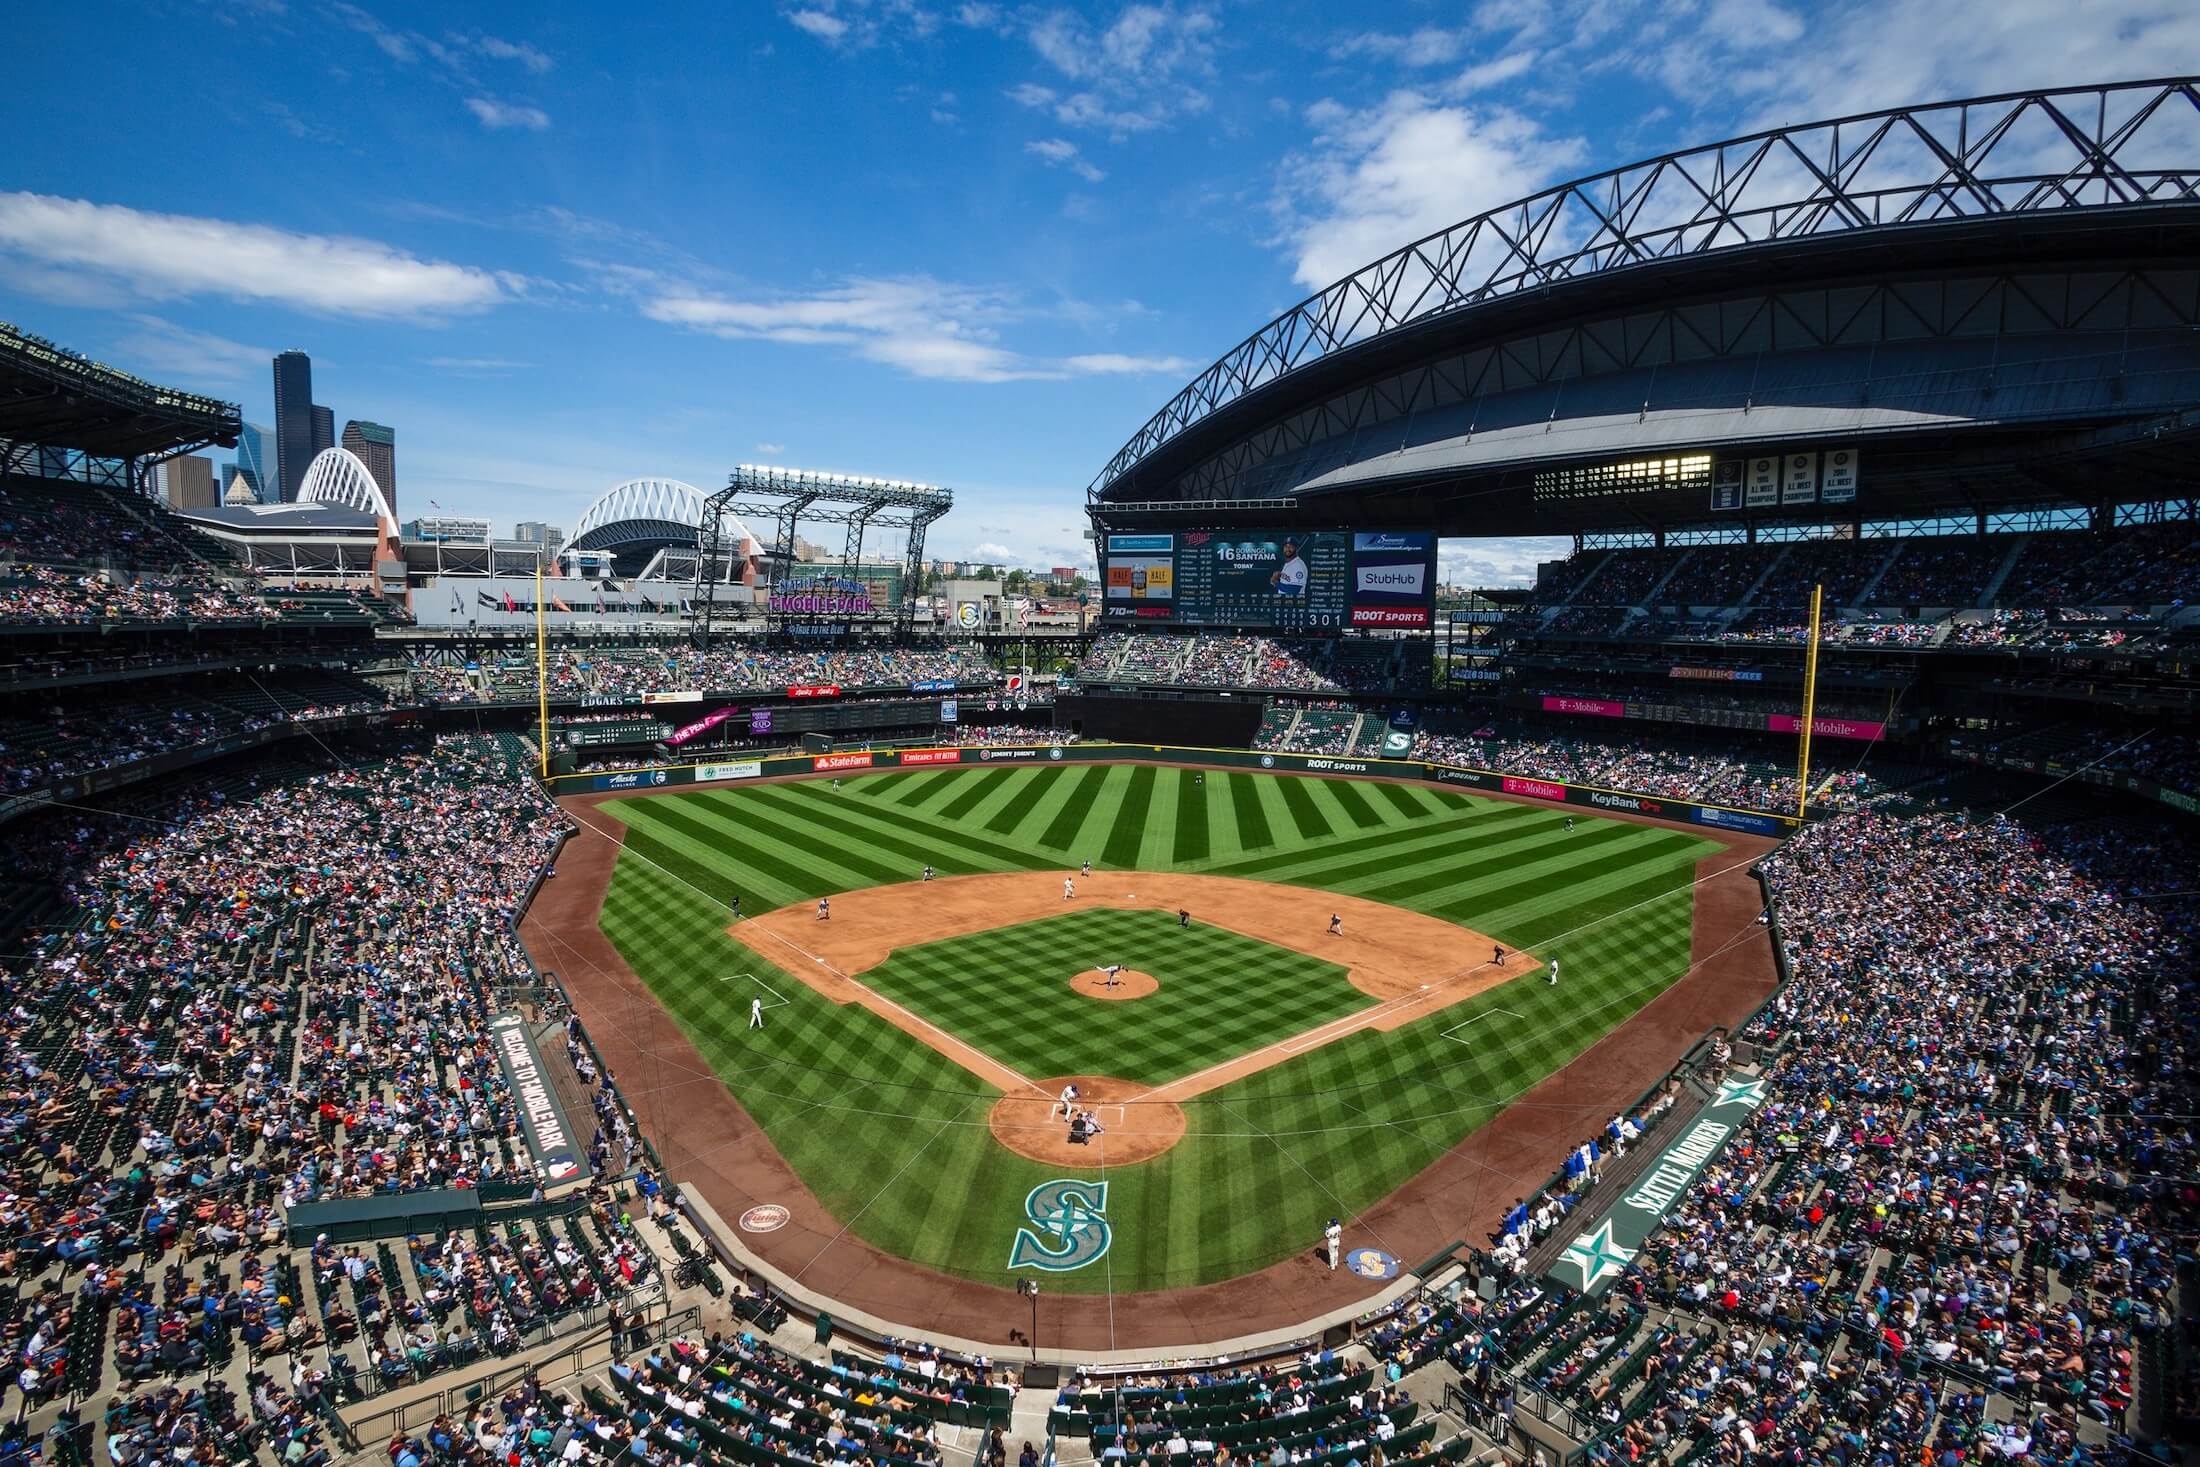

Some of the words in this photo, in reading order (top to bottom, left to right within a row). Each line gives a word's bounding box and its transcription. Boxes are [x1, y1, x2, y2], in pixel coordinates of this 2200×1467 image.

[1217, 548, 1234, 560] 16
[1151, 571, 1166, 579] HALF
[1366, 574, 1414, 584] StubHub
[769, 594, 836, 612] T-MOBILE
[837, 594, 876, 612] PARK
[1309, 615, 1316, 625] 3
[1321, 615, 1329, 625] 0
[1335, 615, 1340, 625] 1
[1353, 611, 1385, 620] ROOT
[1385, 613, 1424, 621] SPORTS
[1452, 612, 1503, 622] COUNTDOWN
[794, 624, 810, 634] TRUE
[811, 625, 817, 634] TO
[819, 625, 830, 634] THE
[830, 624, 845, 634] BLUE
[1484, 672, 1500, 680] DAYS
[1735, 672, 1763, 681] CAFE
[675, 730, 690, 740] THE
[1308, 760, 1333, 769] ROOT
[1334, 763, 1366, 771] SPORTS
[610, 774, 638, 783] Alaska
[1448, 772, 1480, 781] BOEING
[1591, 792, 1640, 809] KeyBank
[501, 1028, 534, 1068] WELCOME
[514, 1066, 538, 1080] TO
[519, 1077, 555, 1123] T-MOBILE
[534, 1119, 567, 1152] PARK
[1624, 1163, 1692, 1215] SEATTLE
[1663, 1118, 1730, 1170] MARINERS
